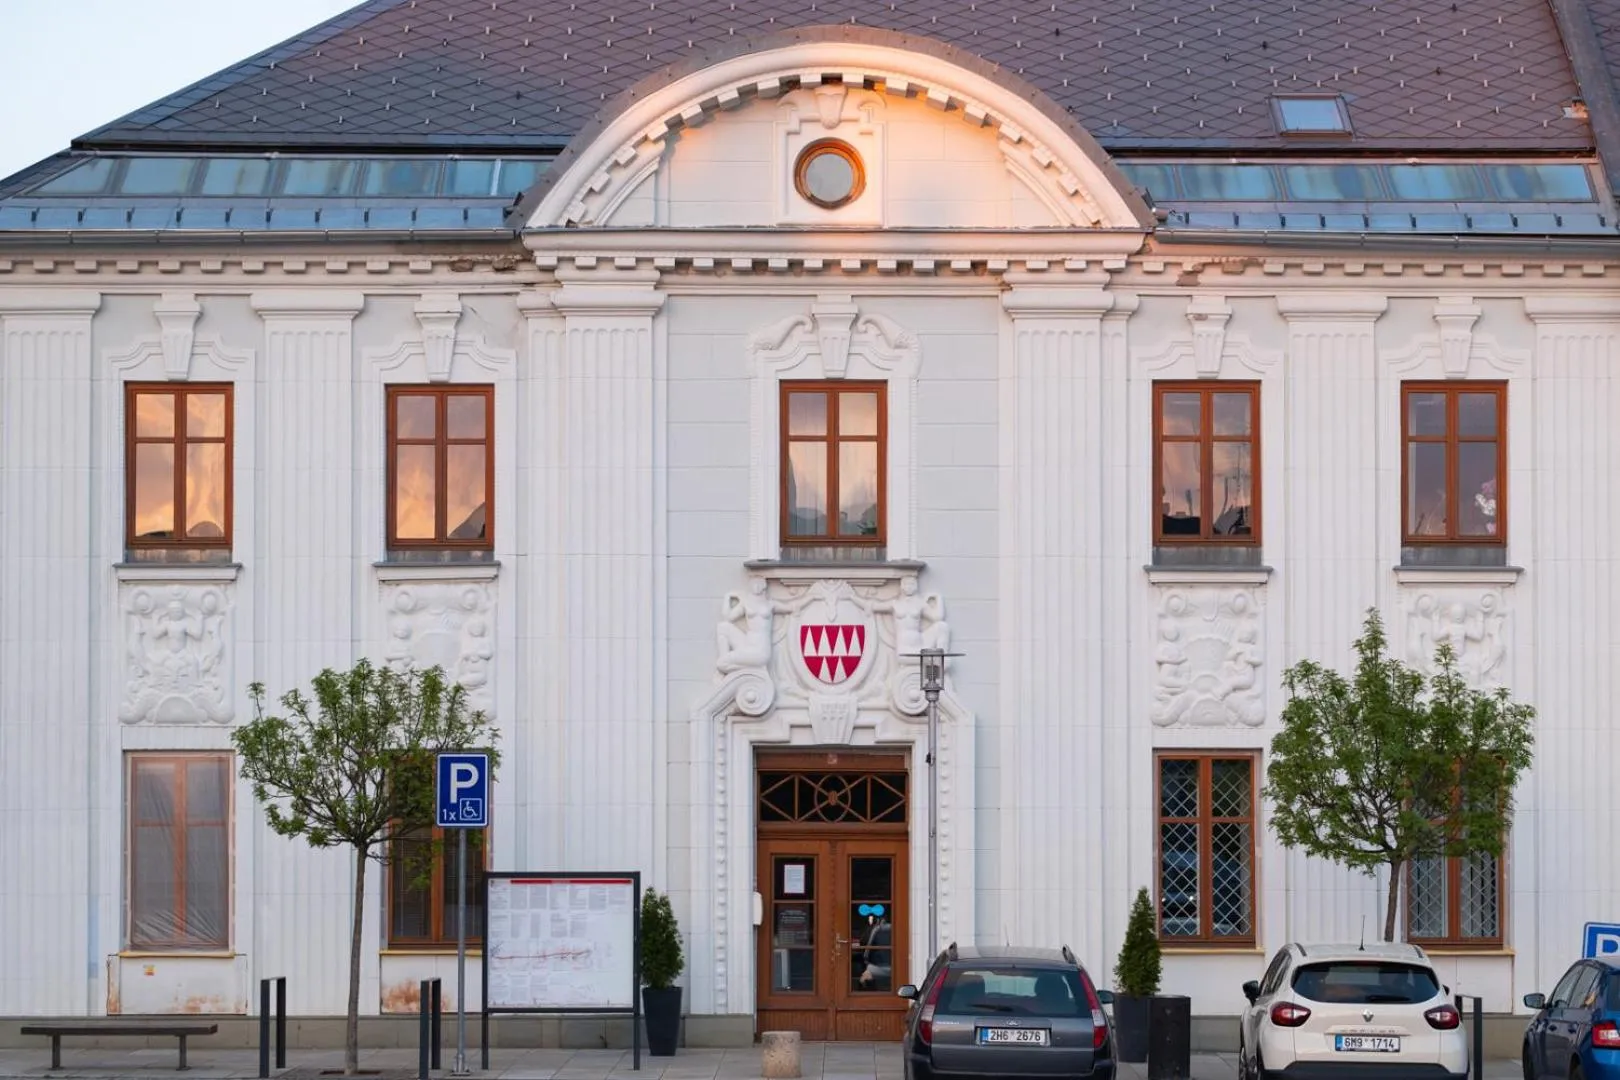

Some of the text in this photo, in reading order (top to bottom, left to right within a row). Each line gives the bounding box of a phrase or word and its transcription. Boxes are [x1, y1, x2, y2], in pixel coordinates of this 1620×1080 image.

[450, 762, 479, 804] P
[442, 808, 457, 821] 1x
[990, 1030, 1009, 1041] 2H6
[1016, 1030, 1041, 1042] 2676
[1371, 1038, 1395, 1048] 1714
